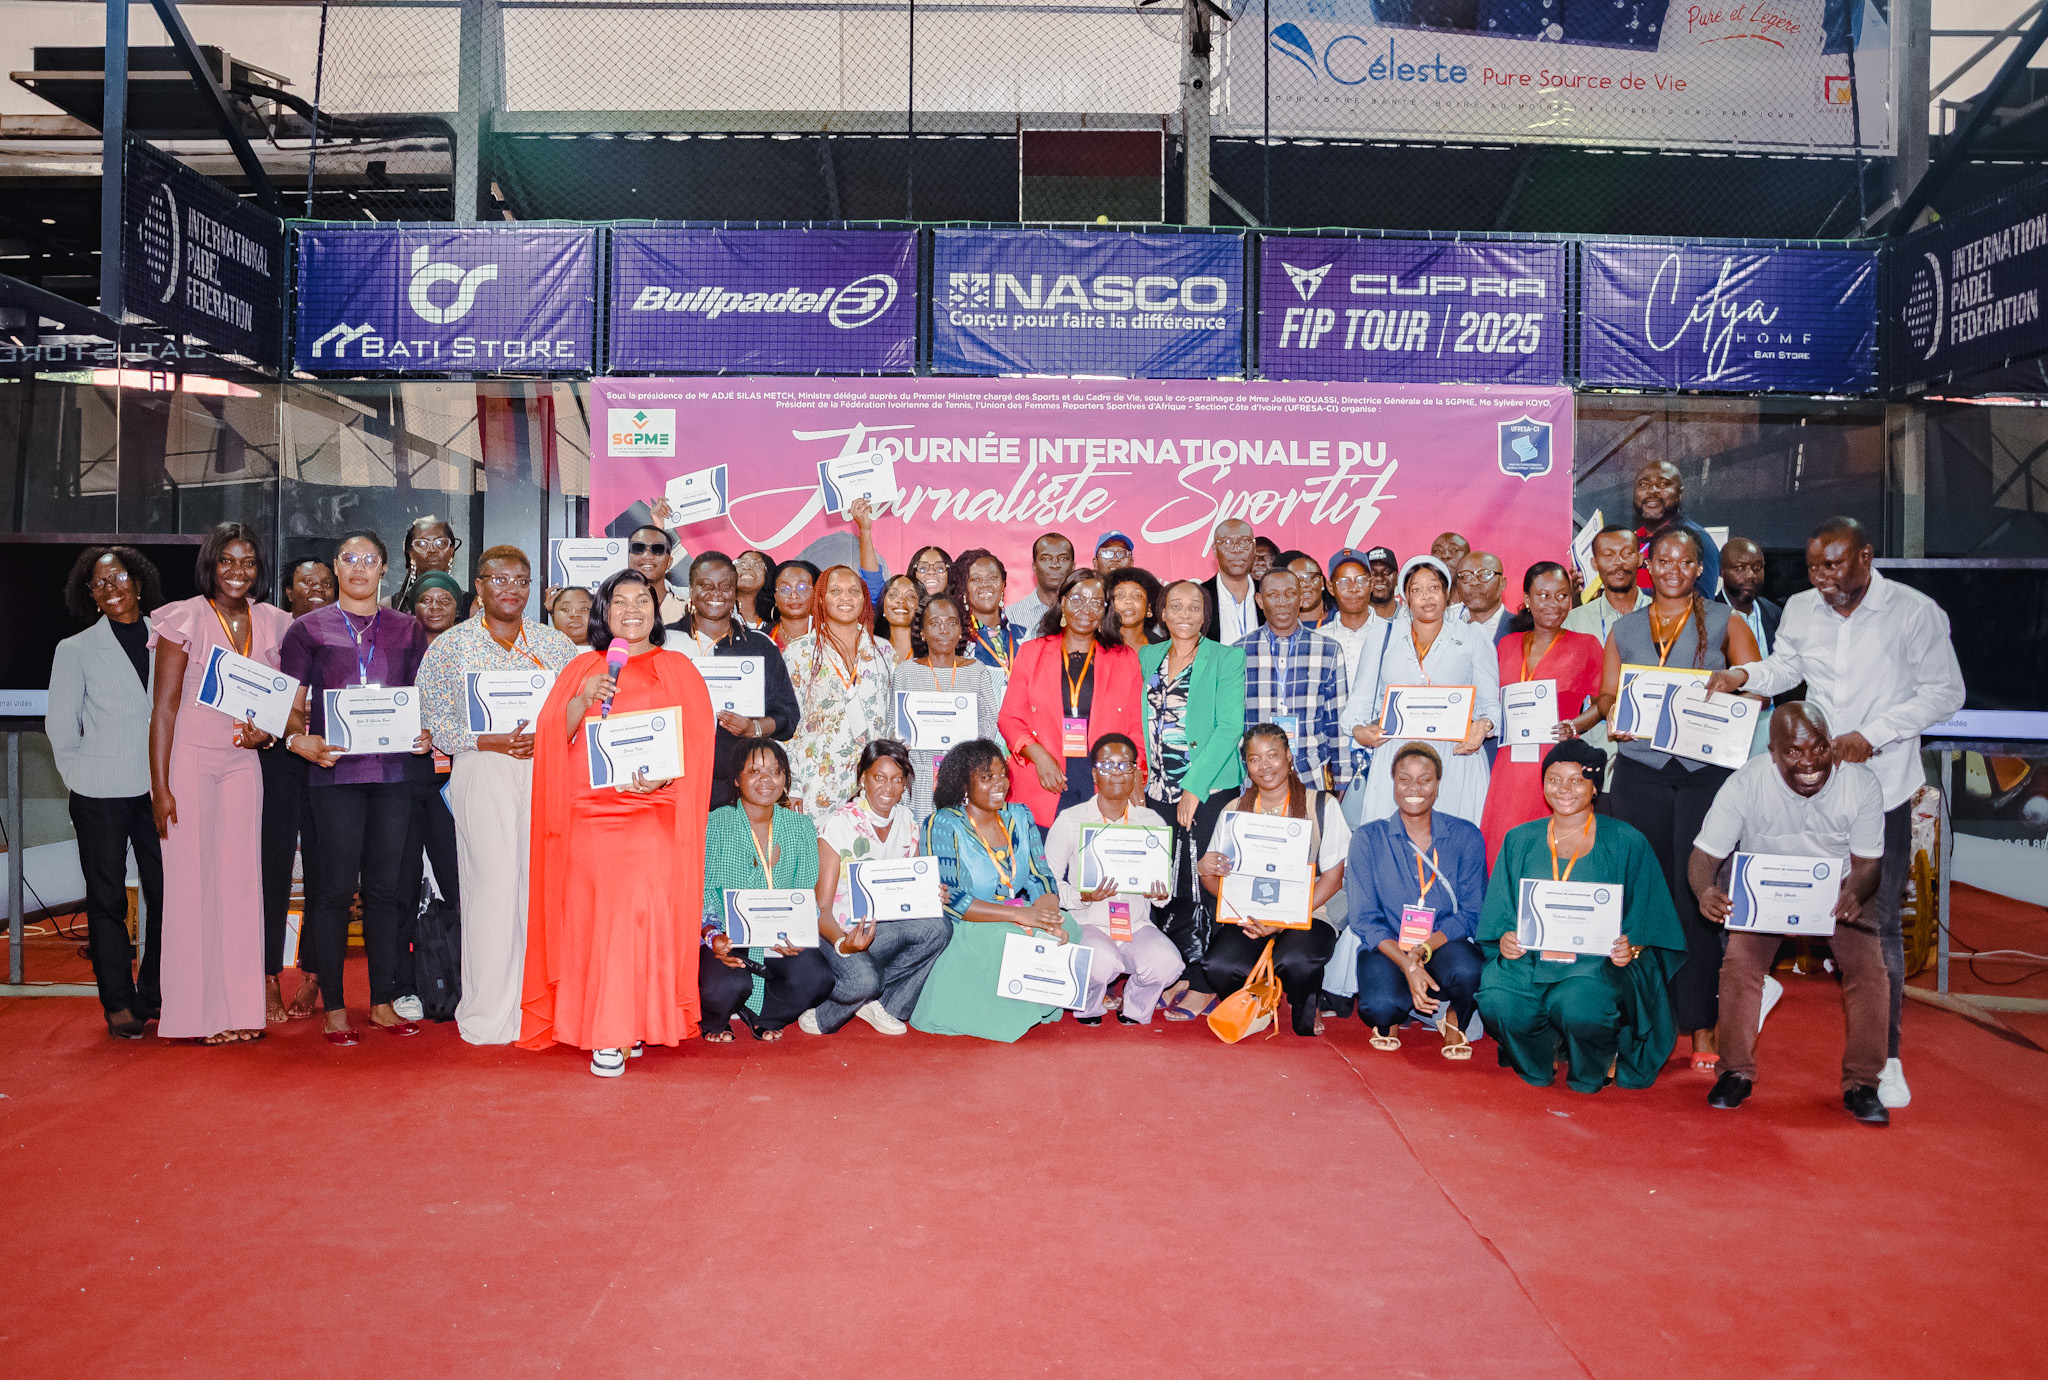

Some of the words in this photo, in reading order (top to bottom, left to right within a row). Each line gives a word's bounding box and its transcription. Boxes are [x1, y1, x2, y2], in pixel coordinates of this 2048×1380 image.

[1688, 5, 1724, 33] Pure
[1729, 4, 1744, 22] et
[1324, 35, 1467, 85] Céleste
[1483, 68, 1531, 87] Pure
[1539, 69, 1611, 90] Source
[1620, 65, 1646, 90] de
[1654, 73, 1687, 91] Vie
[188, 206, 271, 277] INTERNATIONAL
[1951, 213, 2048, 280] INTERNATION
[187, 241, 222, 287] PADEL
[186, 275, 253, 332] FEDERATION
[631, 286, 836, 319] Bullpadel
[994, 274, 1227, 311] NASCO
[1350, 274, 1546, 298] CUPRA
[1951, 269, 1995, 313] PADEL
[949, 310, 1007, 330] Conçu
[1013, 313, 1058, 330] pour
[1063, 312, 1105, 329] faire
[1110, 312, 1127, 329] la
[1131, 312, 1227, 330] différence
[1279, 307, 1336, 349] FIP
[1344, 309, 1431, 351] TOUR
[1454, 312, 1544, 354] 2025
[1951, 288, 2039, 346] FEDERATION
[361, 337, 439, 358] BATI
[452, 337, 575, 358] STORE
[606, 392, 626, 400] Sous
[628, 392, 636, 400] la
[638, 392, 684, 402] présidence
[686, 392, 696, 400] de
[698, 392, 710, 400] Mr
[712, 391, 734, 400] ADJÉ
[736, 392, 762, 400] SILAS
[798, 392, 832, 400] Ministre
[834, 392, 868, 402] délégué
[868, 392, 898, 402] auprès
[900, 393, 910, 401] du
[914, 393, 946, 401] Premier
[948, 393, 982, 401] Ministre
[984, 393, 1012, 403] chargé
[1014, 393, 1030, 402] des
[1032, 393, 1060, 403] Sports
[1062, 394, 1070, 402] et
[1072, 394, 1084, 402] du
[1086, 394, 1112, 402] Cadre
[1112, 394, 1124, 402] de
[1166, 394, 1174, 403] le
[1174, 395, 1234, 405] co-parrainage
[1236, 395, 1246, 403] de
[1248, 395, 1270, 404] Mme
[1272, 395, 1296, 404] Joëlle
[1342, 396, 1382, 405] Directrice
[1384, 397, 1420, 405] Générale
[1422, 397, 1434, 405] de
[1436, 397, 1444, 406] la
[1480, 398, 1492, 406] Me
[1494, 398, 1524, 408] Sylvère
[776, 401, 816, 409] Président
[818, 401, 828, 409] de
[830, 401, 838, 409] la
[840, 401, 886, 409] Fédération
[888, 401, 930, 409] Ivoirienne
[932, 401, 942, 409] de
[946, 401, 974, 411] Tennis,
[976, 401, 1006, 410] l'Union
[1006, 401, 1022, 410] des
[1024, 401, 1060, 410] Femmes
[1062, 402, 1104, 412] Reporters
[1106, 402, 1146, 412] Sportives
[1148, 403, 1186, 413] d'Afrique
[1194, 403, 1226, 411] Section
[1228, 403, 1250, 412] Côte
[1250, 404, 1282, 412] d'Ivoire
[1284, 404, 1338, 412] (UFRESA-CI)
[1340, 405, 1376, 415] organise
[612, 433, 669, 445] SGPME
[1030, 438, 1330, 466] INTERNATIONALE
[1338, 441, 1387, 467] DU
[1141, 458, 1399, 558] Sportif
